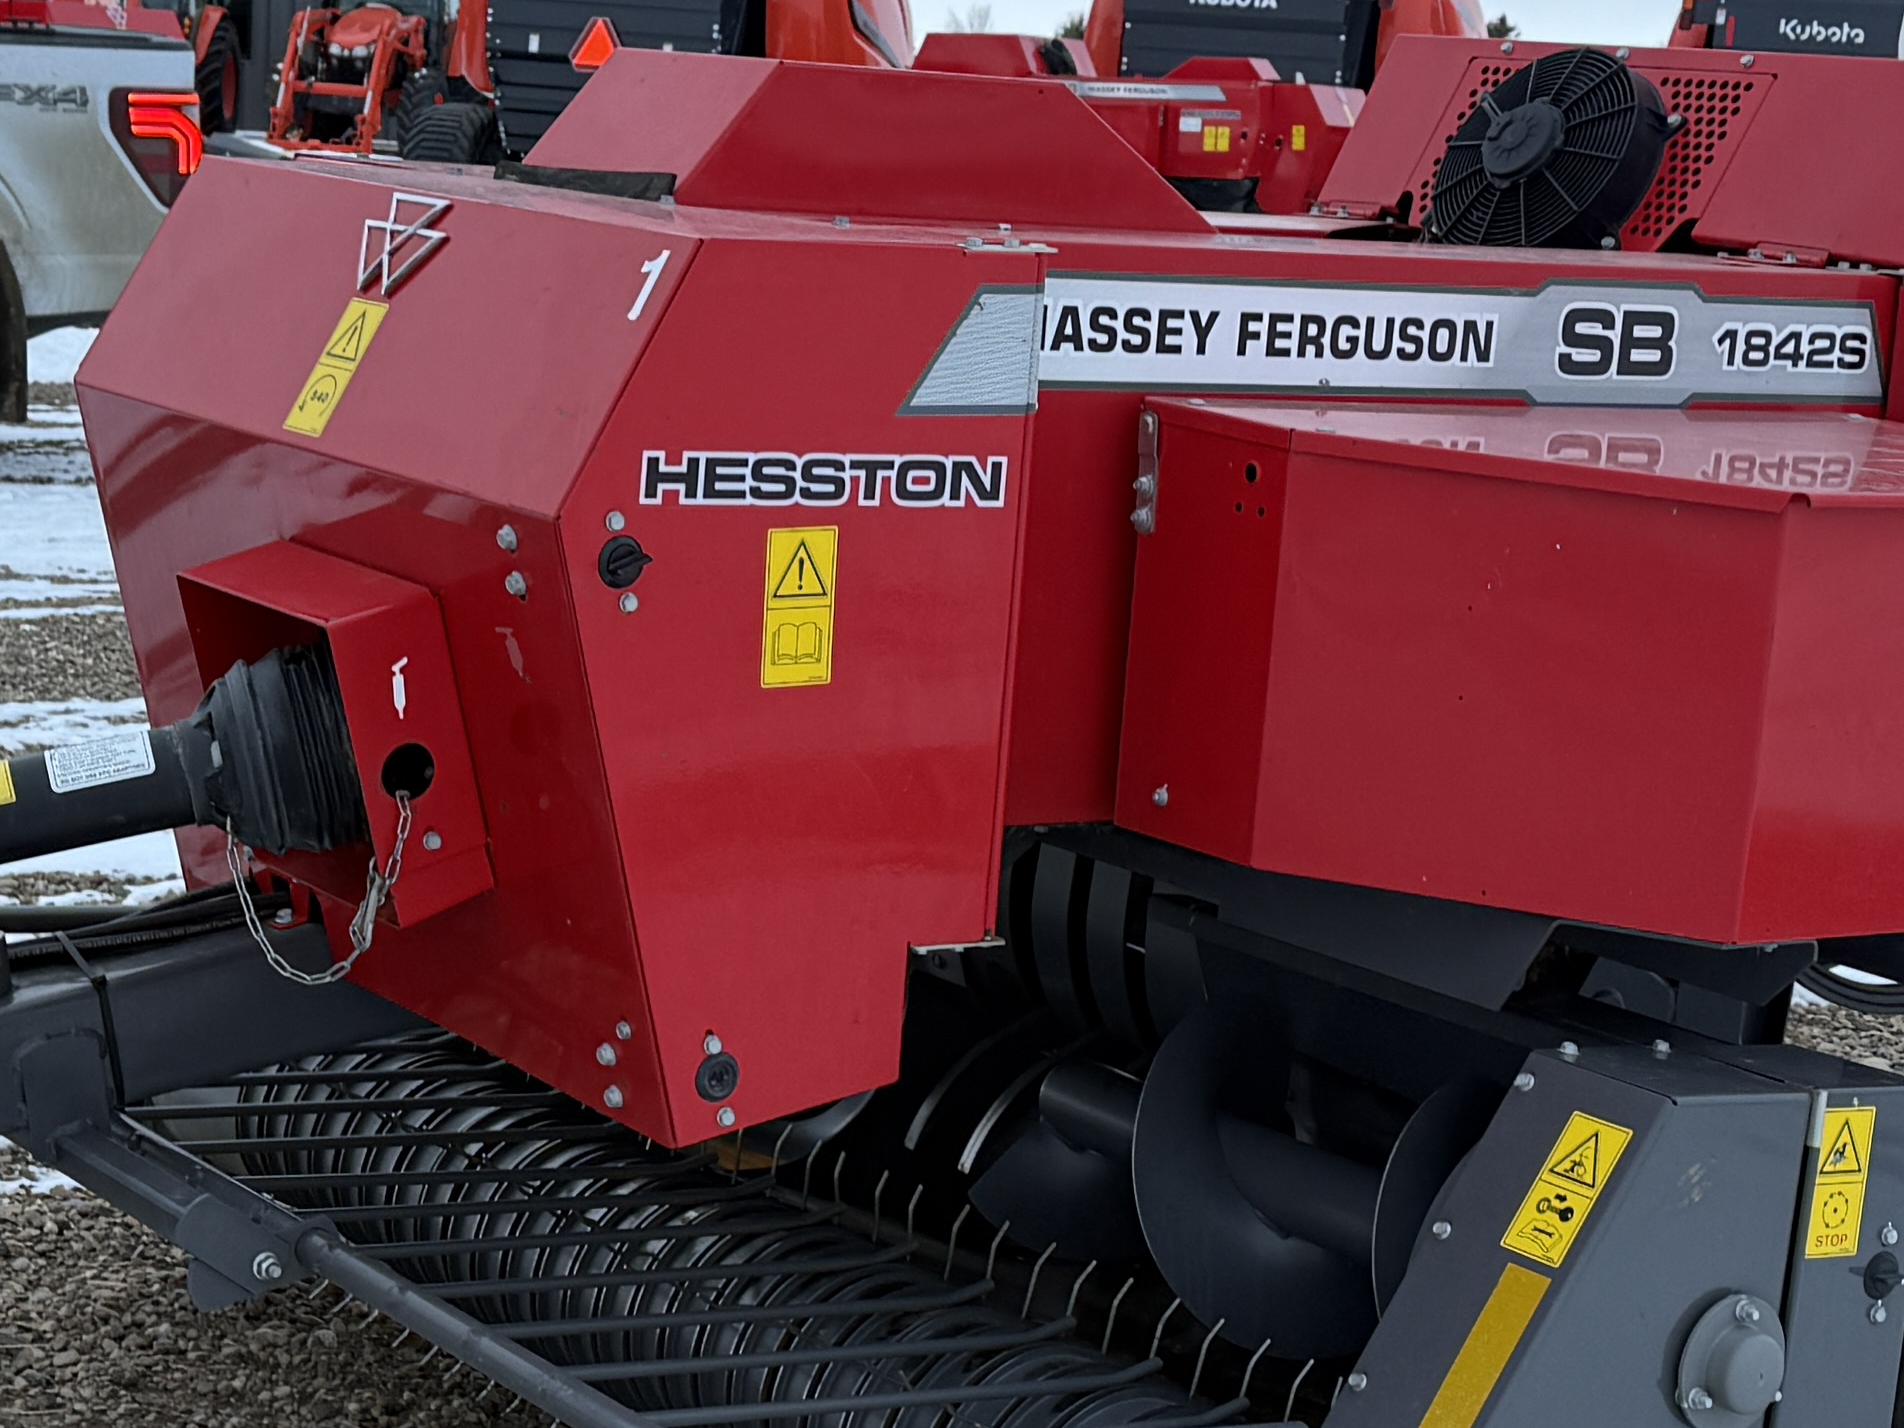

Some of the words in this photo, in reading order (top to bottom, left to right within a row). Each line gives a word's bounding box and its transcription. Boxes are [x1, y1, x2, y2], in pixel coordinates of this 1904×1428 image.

[1778, 18, 1865, 44] Kubota
[1040, 304, 1220, 356] ASSEY
[1236, 310, 1494, 363] FERGUSON
[1556, 305, 1678, 378] SB
[1715, 327, 1868, 371] 1842S
[642, 453, 1005, 504] HESSTON
[1814, 1232, 1848, 1248] STOP
